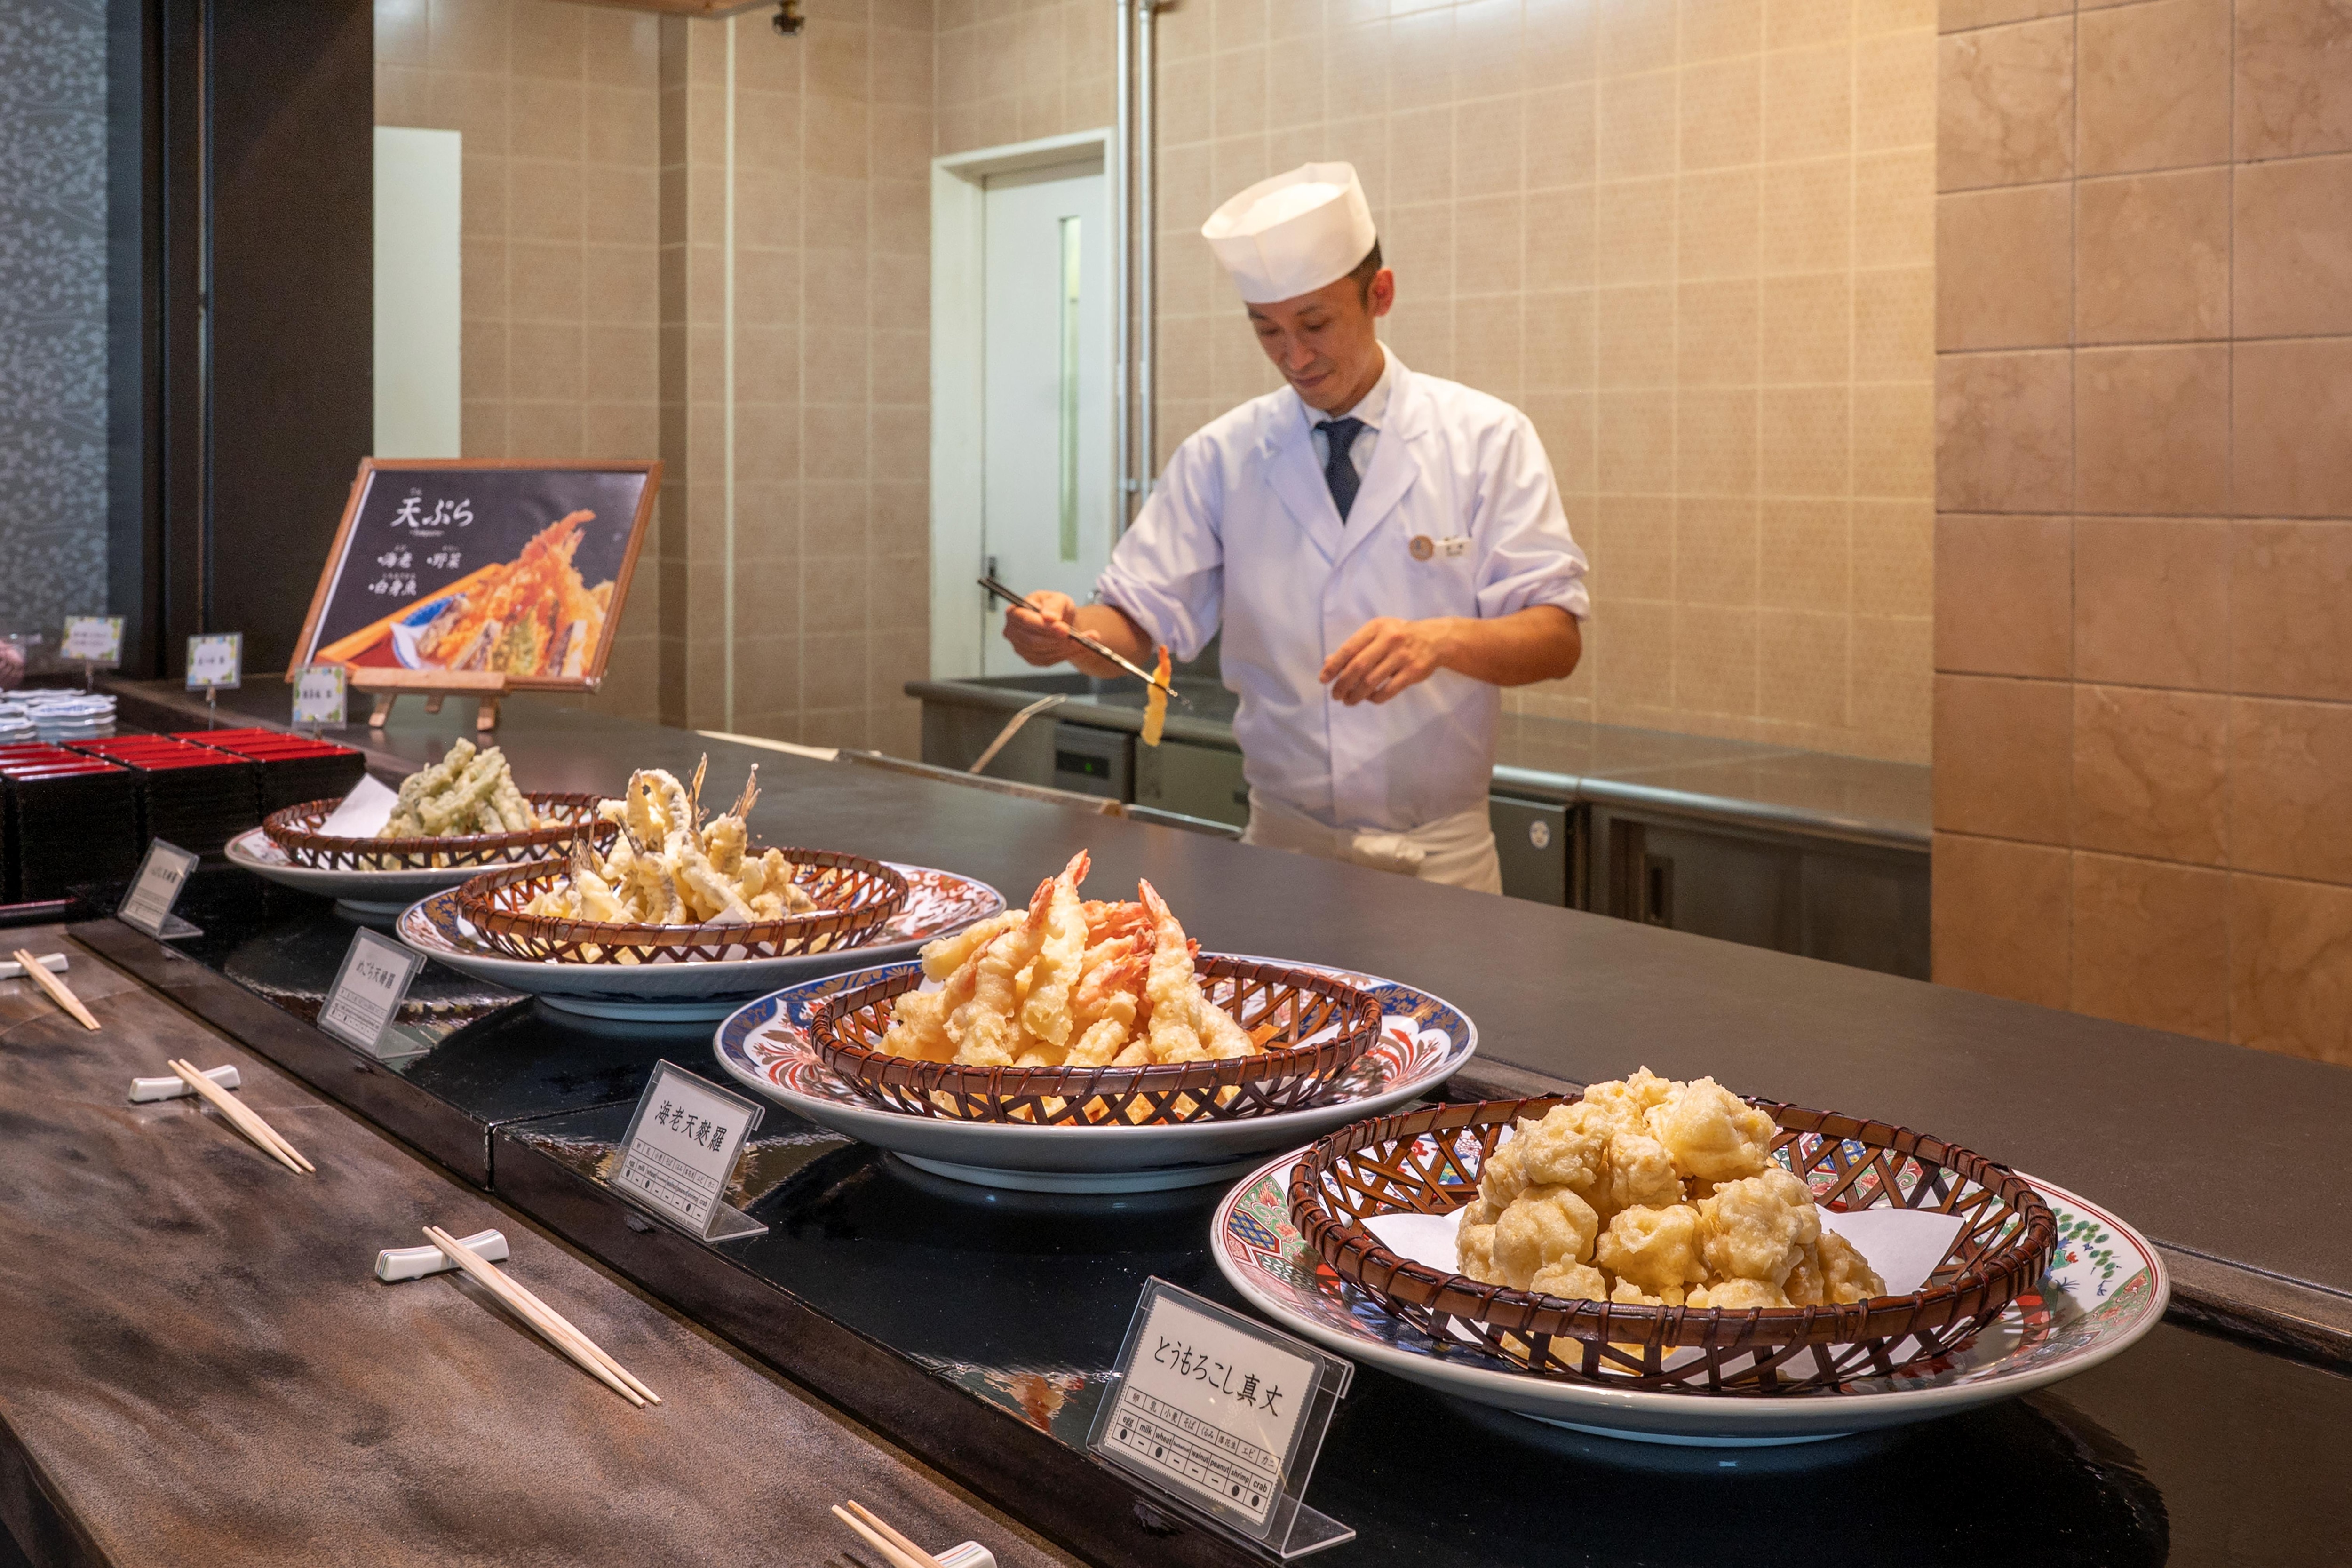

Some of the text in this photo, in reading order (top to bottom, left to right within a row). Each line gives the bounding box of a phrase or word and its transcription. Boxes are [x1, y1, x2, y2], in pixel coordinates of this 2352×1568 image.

[390, 497, 473, 527] 天ぷら
[1154, 1336, 1283, 1417] とうもろこし真丈
[1123, 1416, 1134, 1428] egg
[1139, 1424, 1152, 1435] milk
[1155, 1432, 1172, 1445] wheat
[1191, 1450, 1209, 1463] walnut
[1210, 1459, 1230, 1473] peanut
[1231, 1470, 1249, 1483] shrimp
[1253, 1480, 1268, 1493] crab
[1184, 1417, 1197, 1430] そば
[1201, 1426, 1213, 1439] くるみ
[1242, 1447, 1256, 1458] エビ
[1261, 1456, 1274, 1467] カニ
